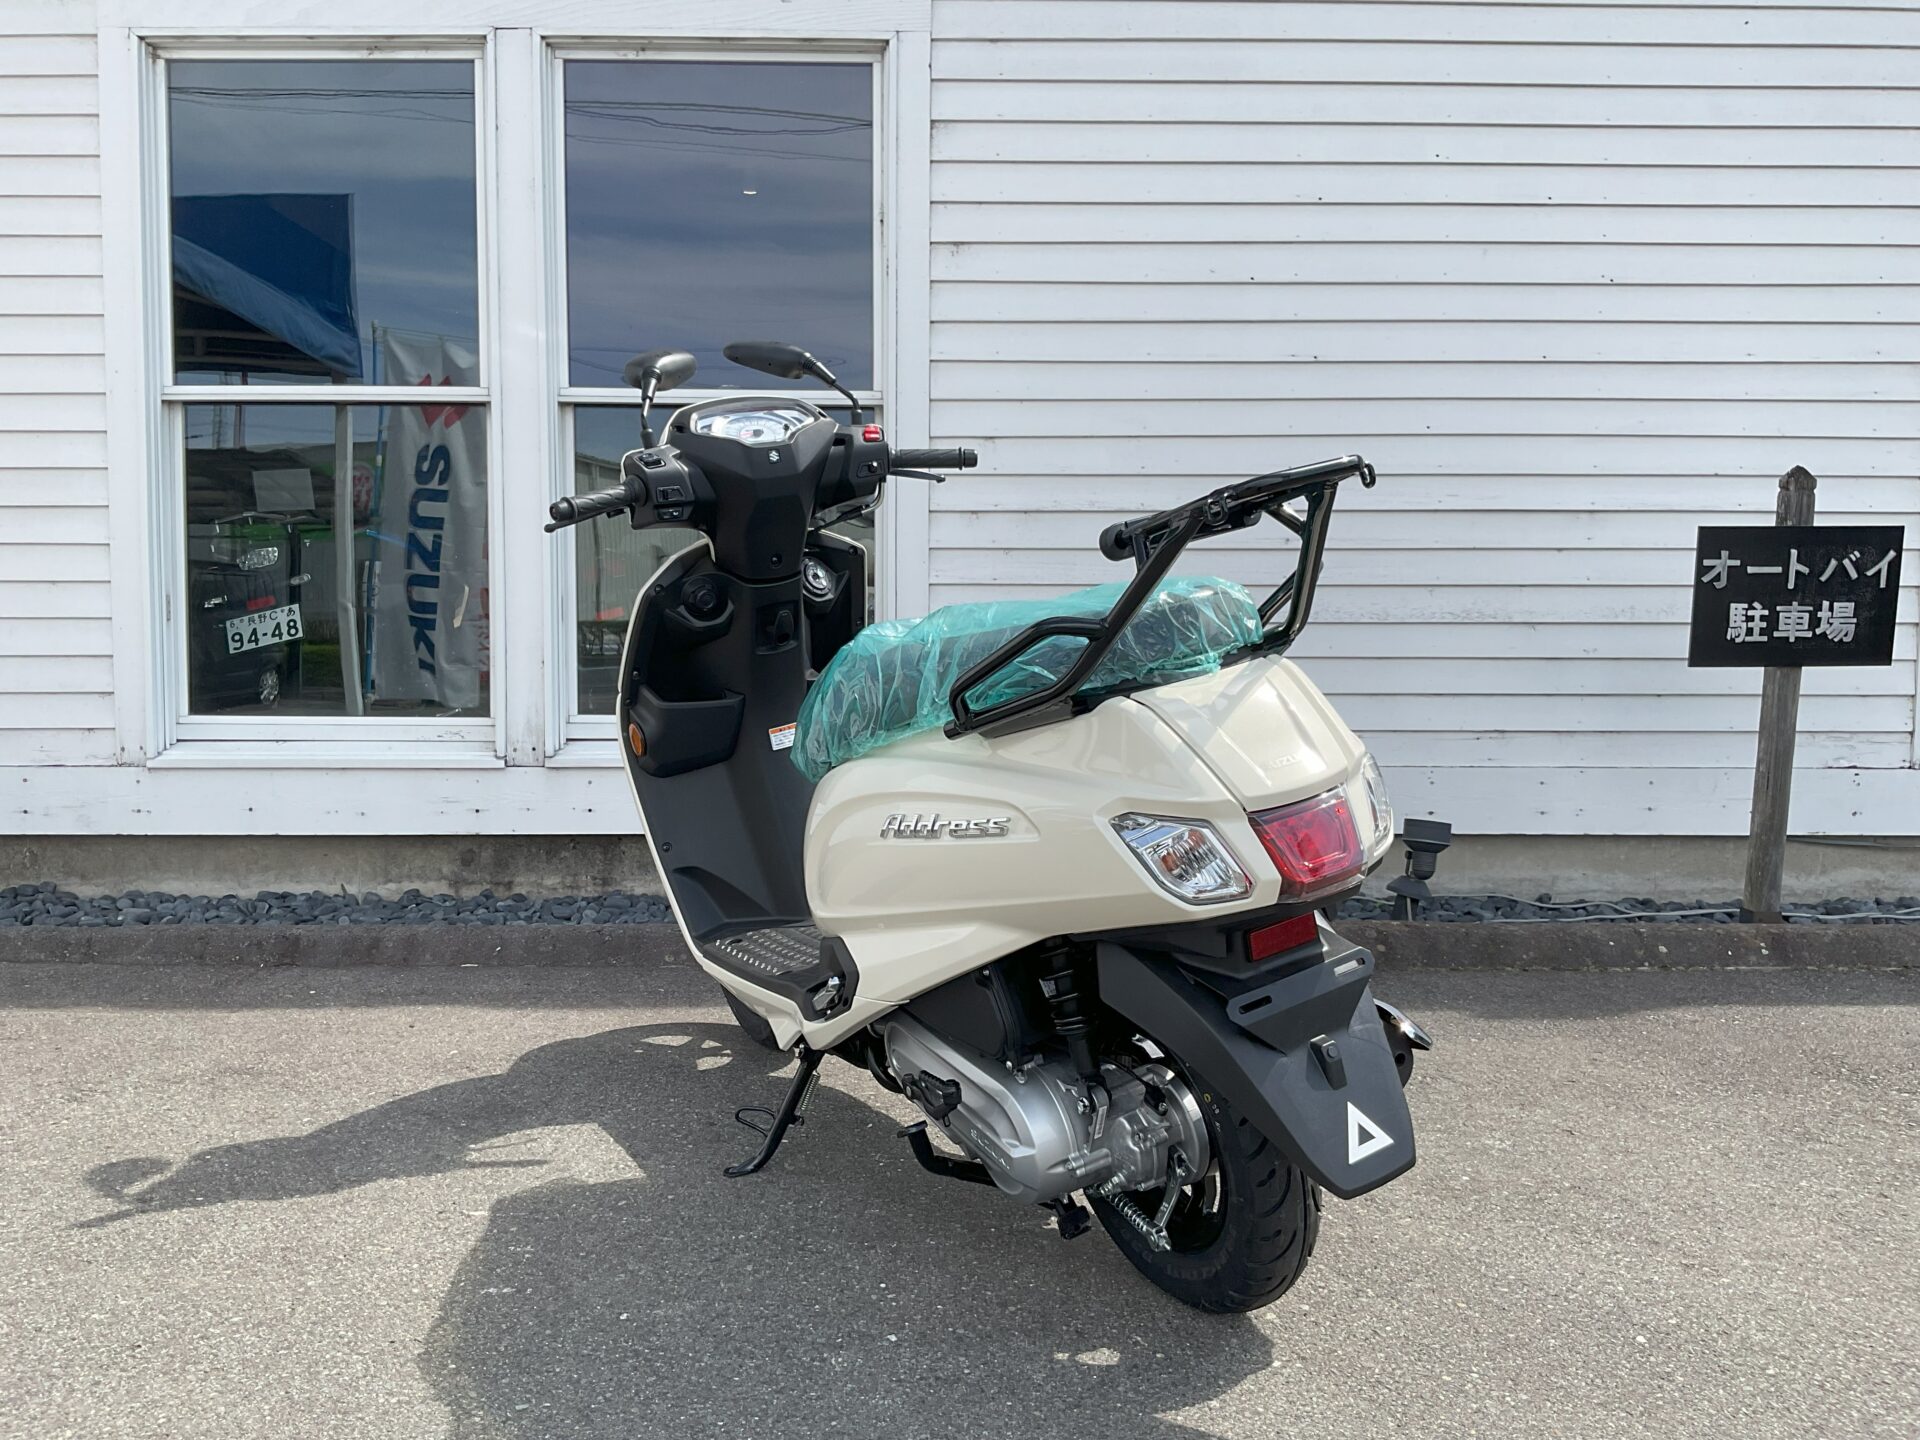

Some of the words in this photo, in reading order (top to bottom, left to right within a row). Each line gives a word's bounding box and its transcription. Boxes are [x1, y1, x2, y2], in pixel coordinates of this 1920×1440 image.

[406, 444, 451, 676] SUZUKI
[1700, 549, 1897, 590] オートバイ
[230, 618, 300, 651] 94-48
[1726, 600, 1858, 644] 駐車場
[879, 813, 1012, 840] Address
